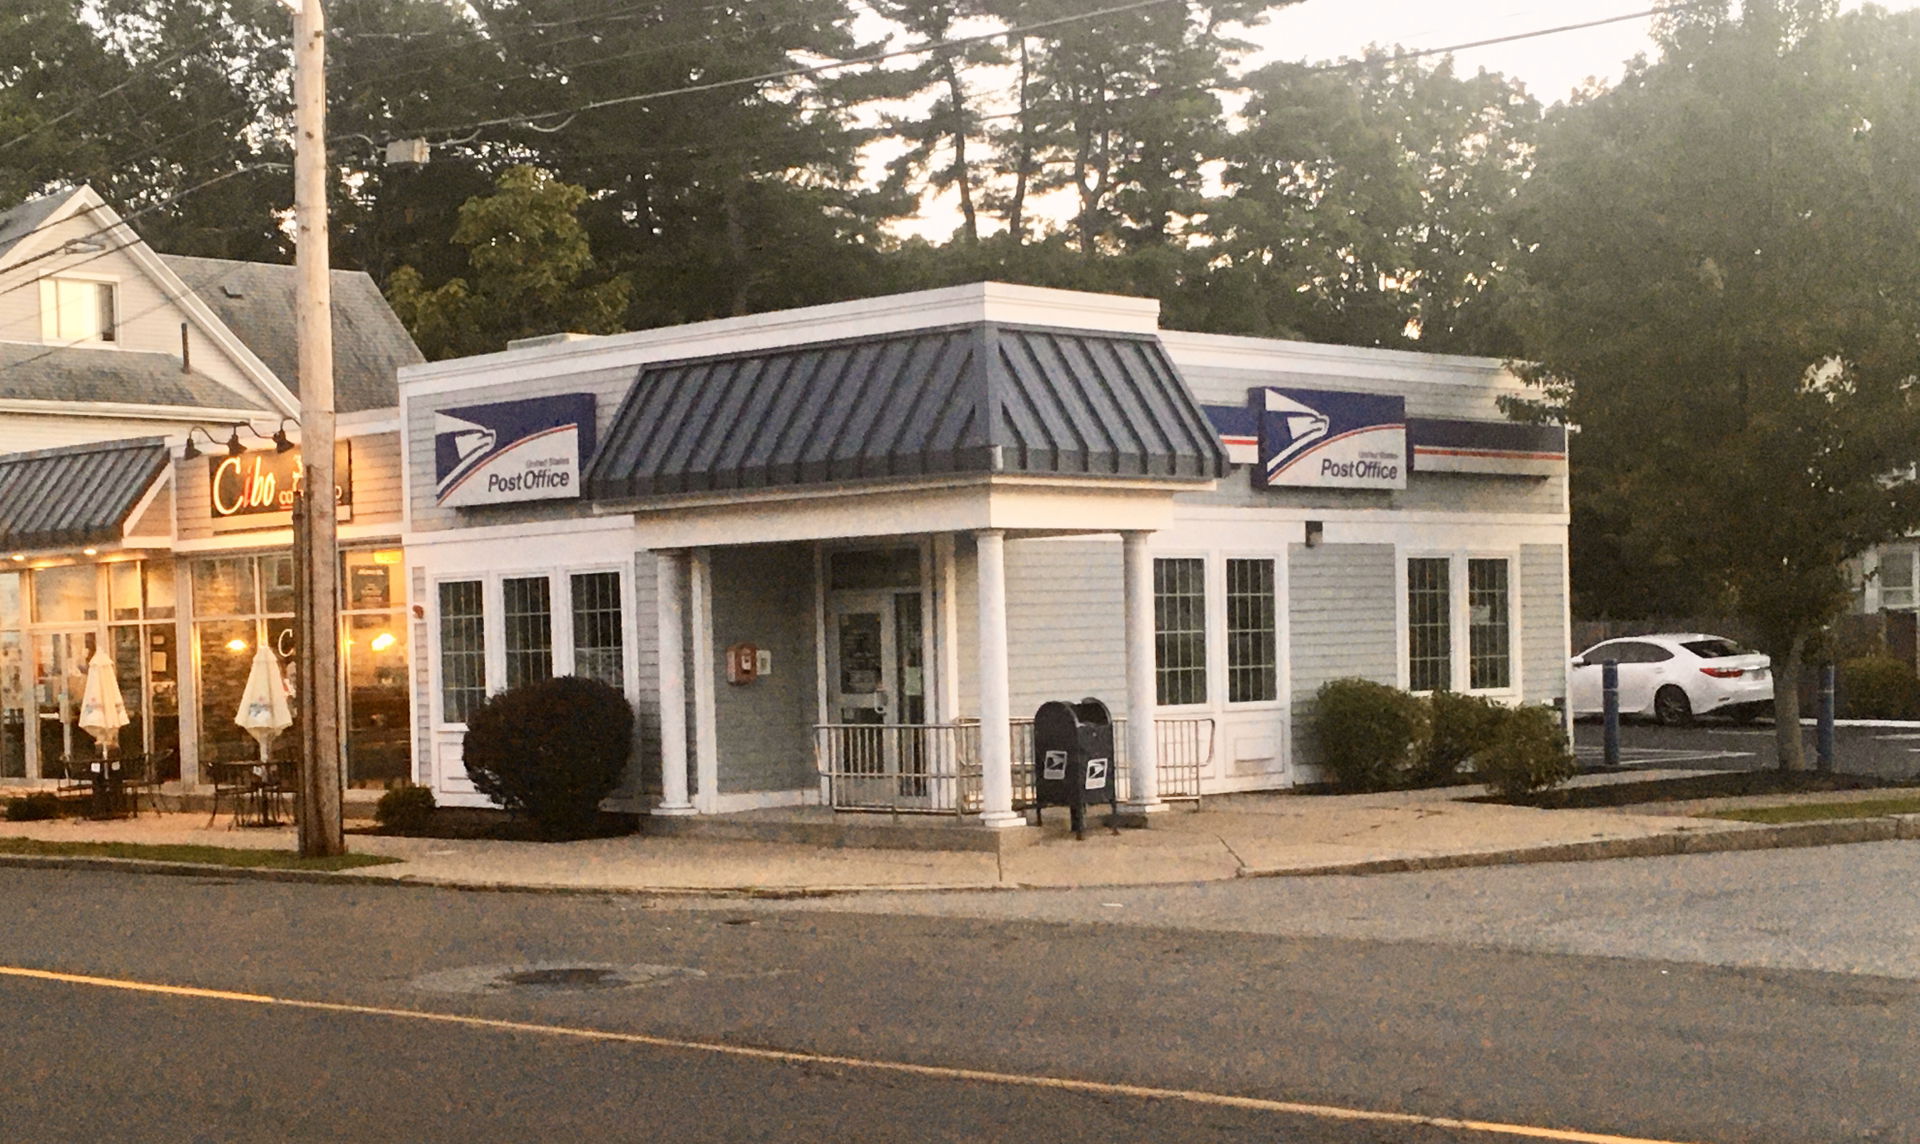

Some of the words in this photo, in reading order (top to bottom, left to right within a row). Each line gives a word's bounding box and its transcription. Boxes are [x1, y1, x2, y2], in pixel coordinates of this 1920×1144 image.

[488, 473, 522, 492] Post
[524, 469, 569, 489] Office
[1321, 459, 1354, 477] Post
[1355, 461, 1397, 479] Office
[213, 456, 276, 515] Cibo
